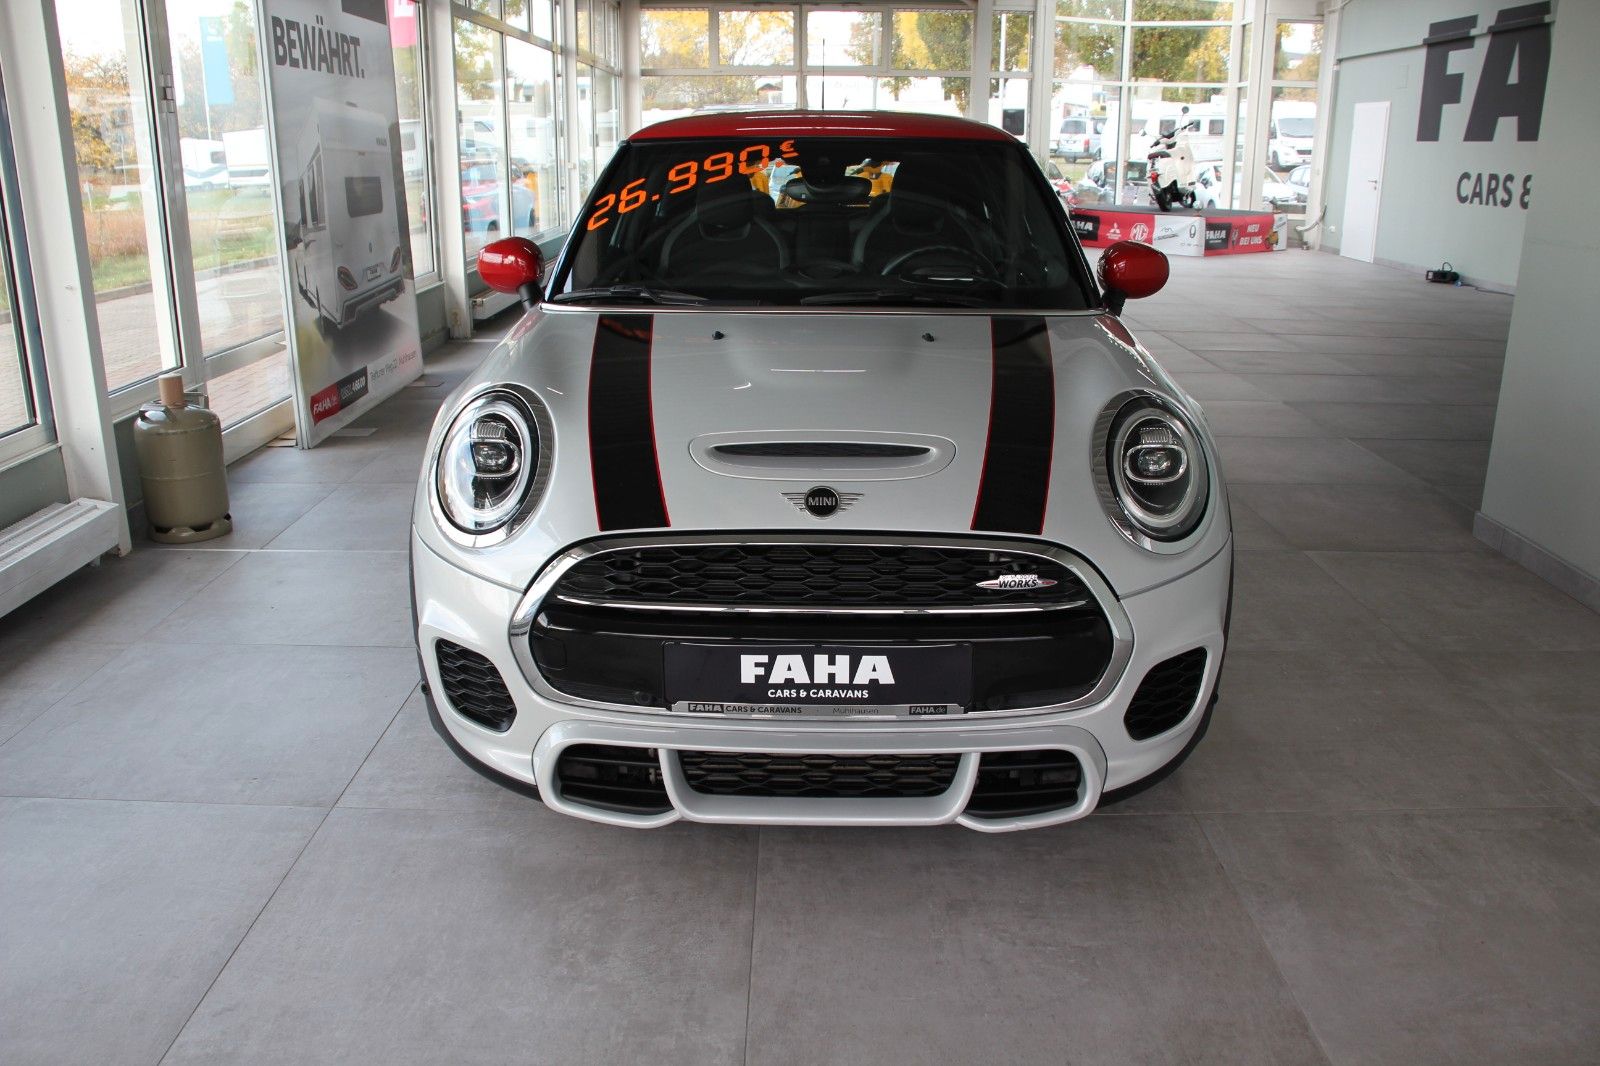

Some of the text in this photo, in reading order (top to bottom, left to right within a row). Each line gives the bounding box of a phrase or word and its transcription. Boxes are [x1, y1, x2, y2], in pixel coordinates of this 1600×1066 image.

[272, 15, 365, 78] BEWÄHRT.
[1457, 172, 1515, 208] CARS
[1247, 224, 1260, 232] NEU
[1206, 230, 1226, 239] FAHA
[808, 497, 836, 506] MINI
[999, 579, 1038, 588] WORKS
[741, 655, 895, 684] FAHA
[768, 689, 869, 698] CARS & CARAVANS
[689, 704, 722, 713] FAHA
[725, 705, 748, 713] CARS
[758, 706, 803, 714] CARAVANS
[911, 706, 946, 714] FAHA.de
